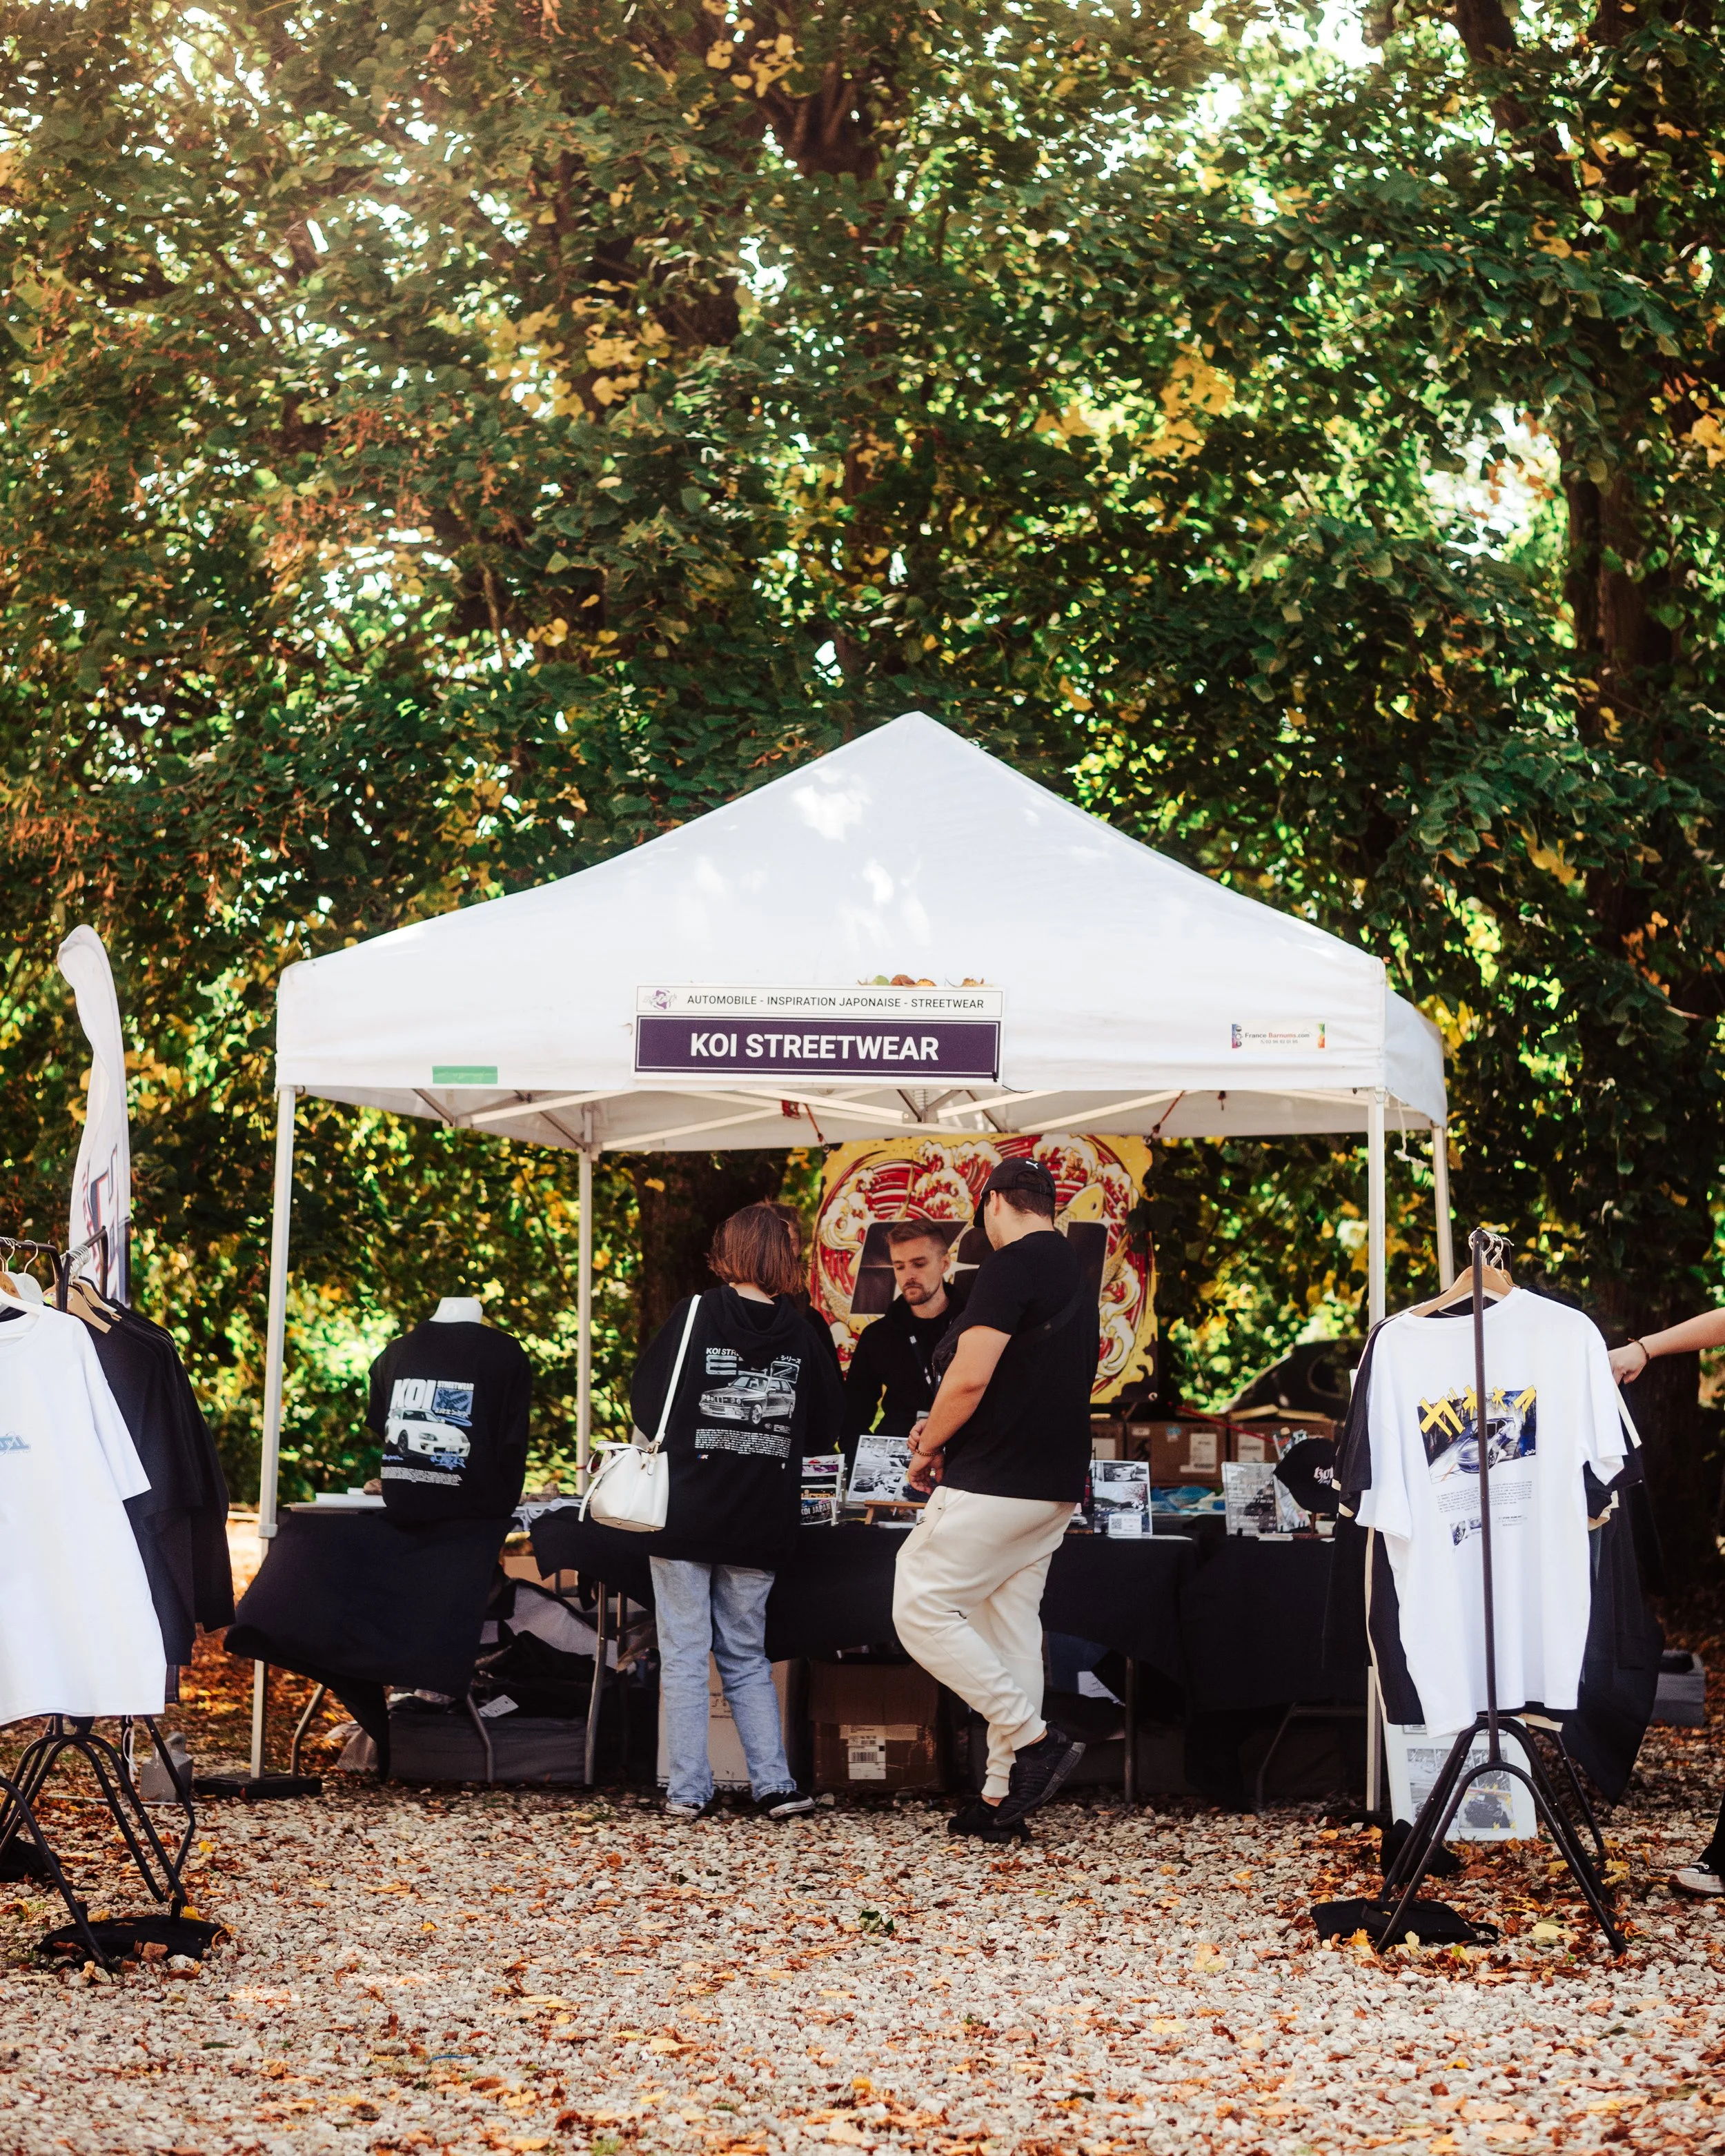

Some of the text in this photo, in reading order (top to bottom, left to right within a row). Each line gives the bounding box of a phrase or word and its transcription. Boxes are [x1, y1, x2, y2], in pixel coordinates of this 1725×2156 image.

[687, 996, 756, 1005] AUTOMOBILE
[767, 996, 835, 1006] INSPIRATION
[840, 998, 900, 1007] JAPONAISE
[911, 999, 984, 1008] STREETWEAR
[691, 1033, 939, 1060] KOI STREETWEAR
[390, 1378, 437, 1409] KOI
